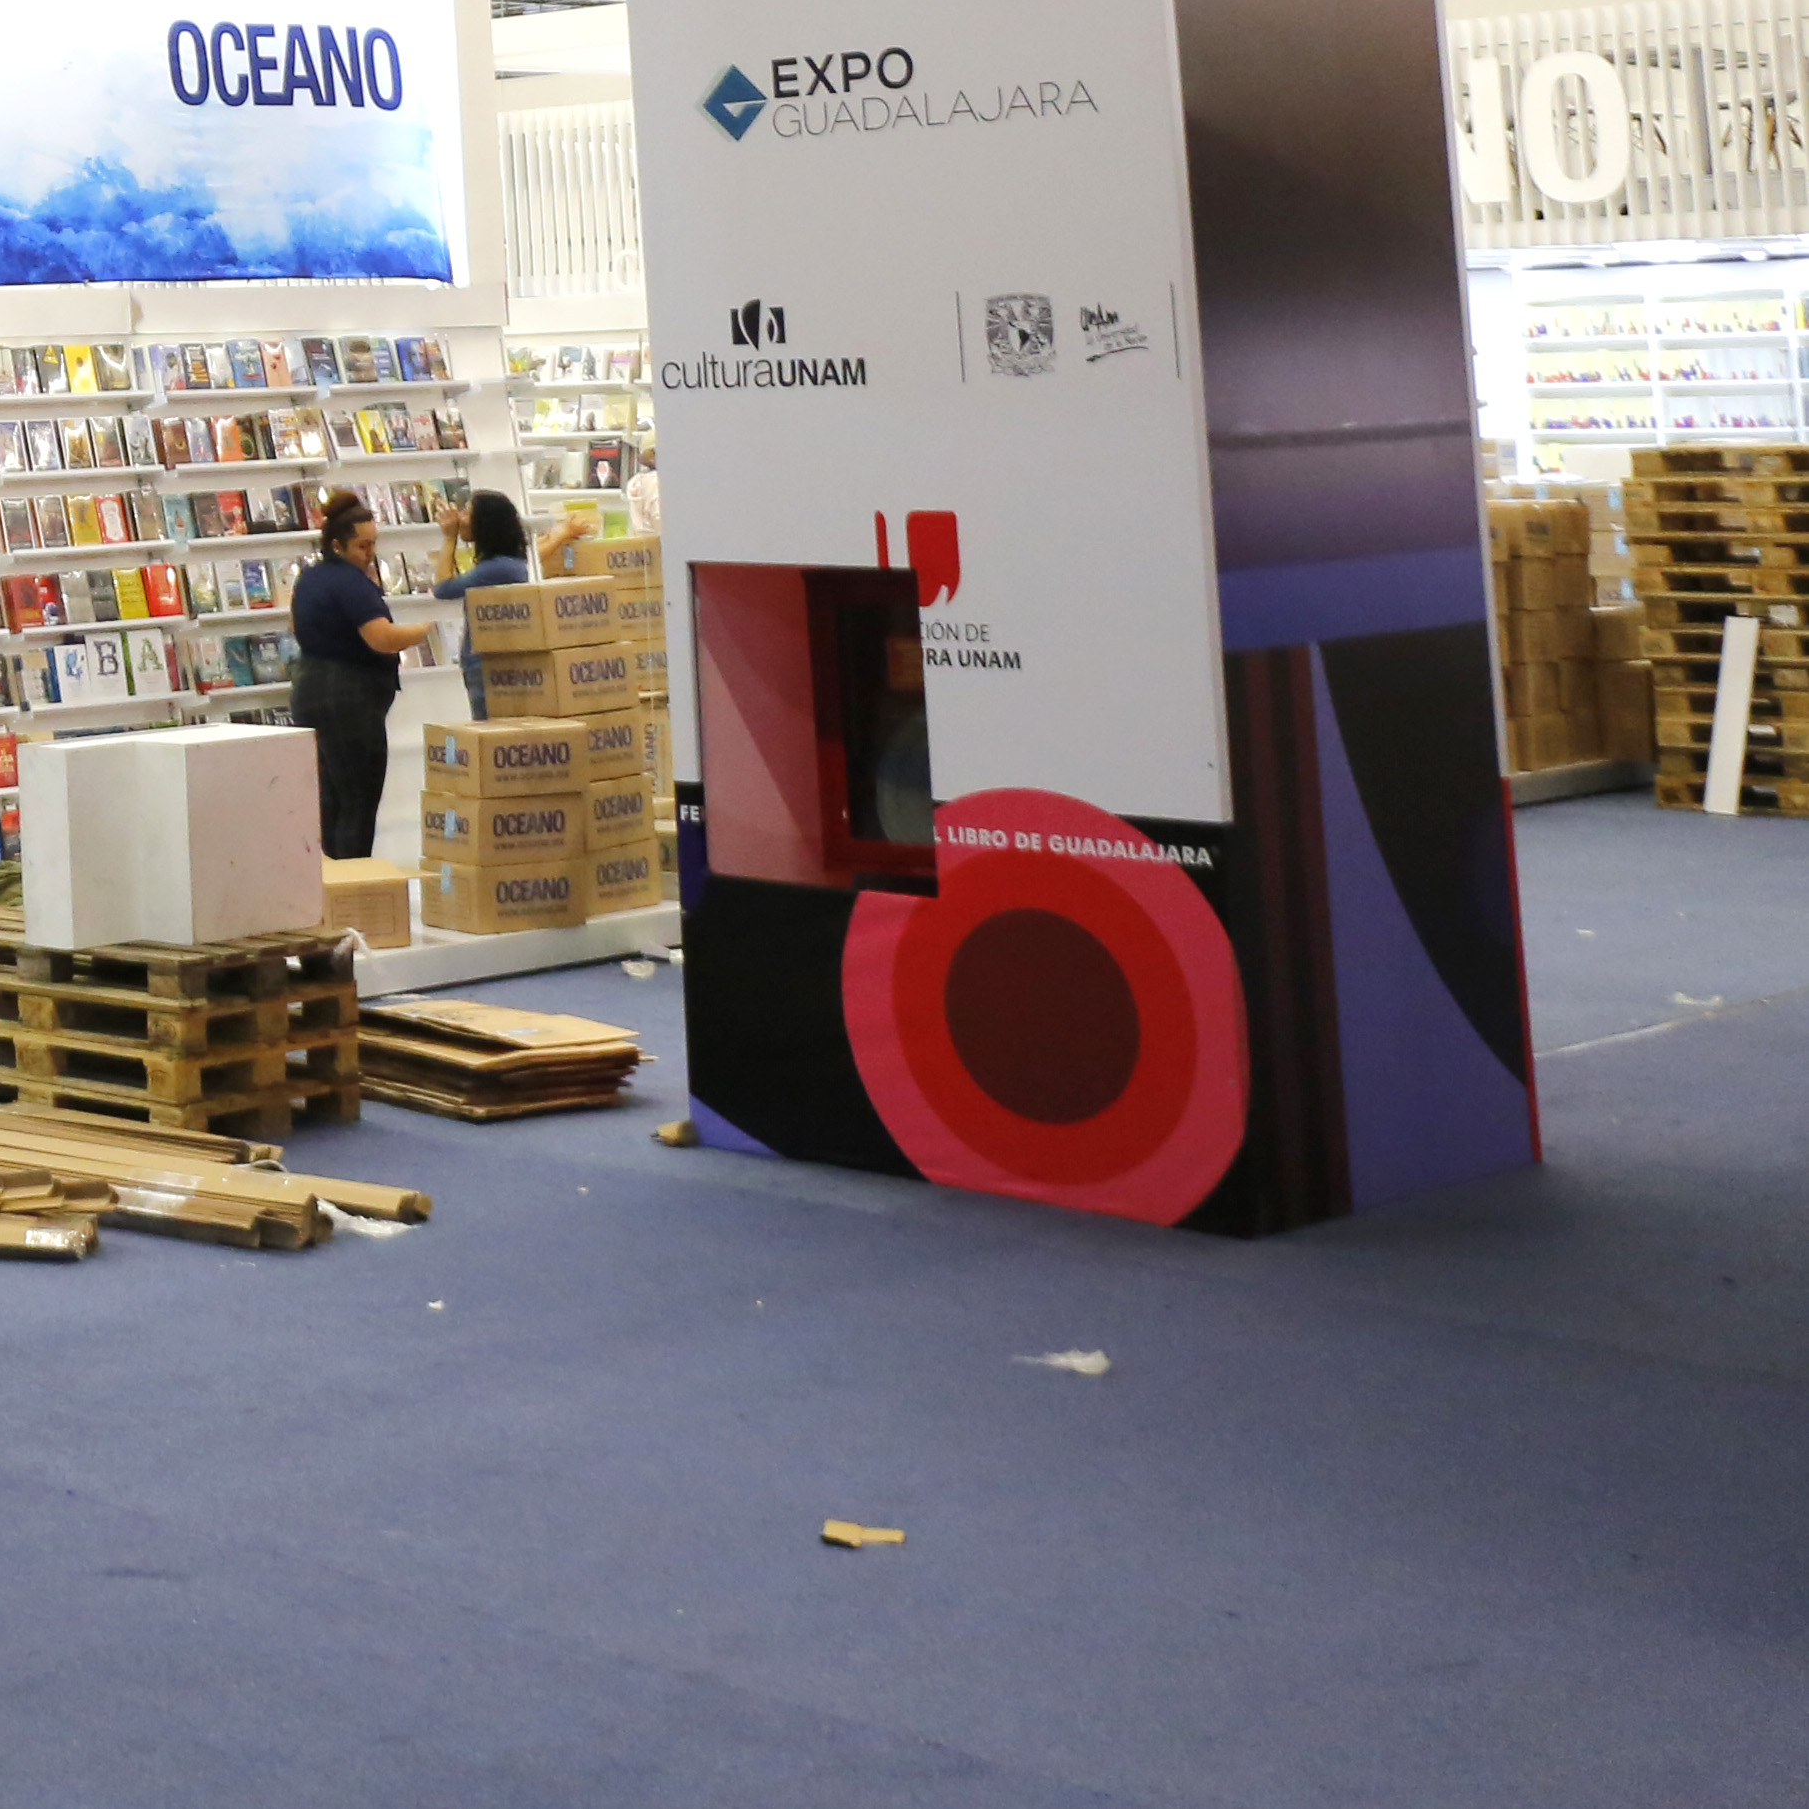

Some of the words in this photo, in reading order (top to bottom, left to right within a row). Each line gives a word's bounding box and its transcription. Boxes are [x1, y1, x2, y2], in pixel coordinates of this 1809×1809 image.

[167, 19, 403, 111] OCEANO
[771, 46, 915, 100] EXPO
[772, 79, 1099, 141] GUADALAJARA
[661, 351, 867, 391] culturaUNAM
[607, 549, 652, 570] OCEANO
[476, 603, 530, 621] OCEANO
[555, 593, 608, 619] OCEANO
[966, 623, 990, 642] DE
[570, 658, 626, 684] OCEANO
[958, 649, 1022, 670] UNAM
[490, 669, 543, 686] OCEANO
[588, 725, 633, 752] CEANO
[427, 744, 469, 767] OCENO
[494, 742, 570, 769] OCEANO
[594, 793, 643, 821] OCEANO
[426, 812, 469, 834] OCENO
[493, 809, 566, 836] OCEANO
[948, 826, 1008, 849] LIBRO
[1015, 831, 1043, 852] DE
[1050, 835, 1212, 867] GUADALAJARA
[496, 877, 570, 904] OCEANO
